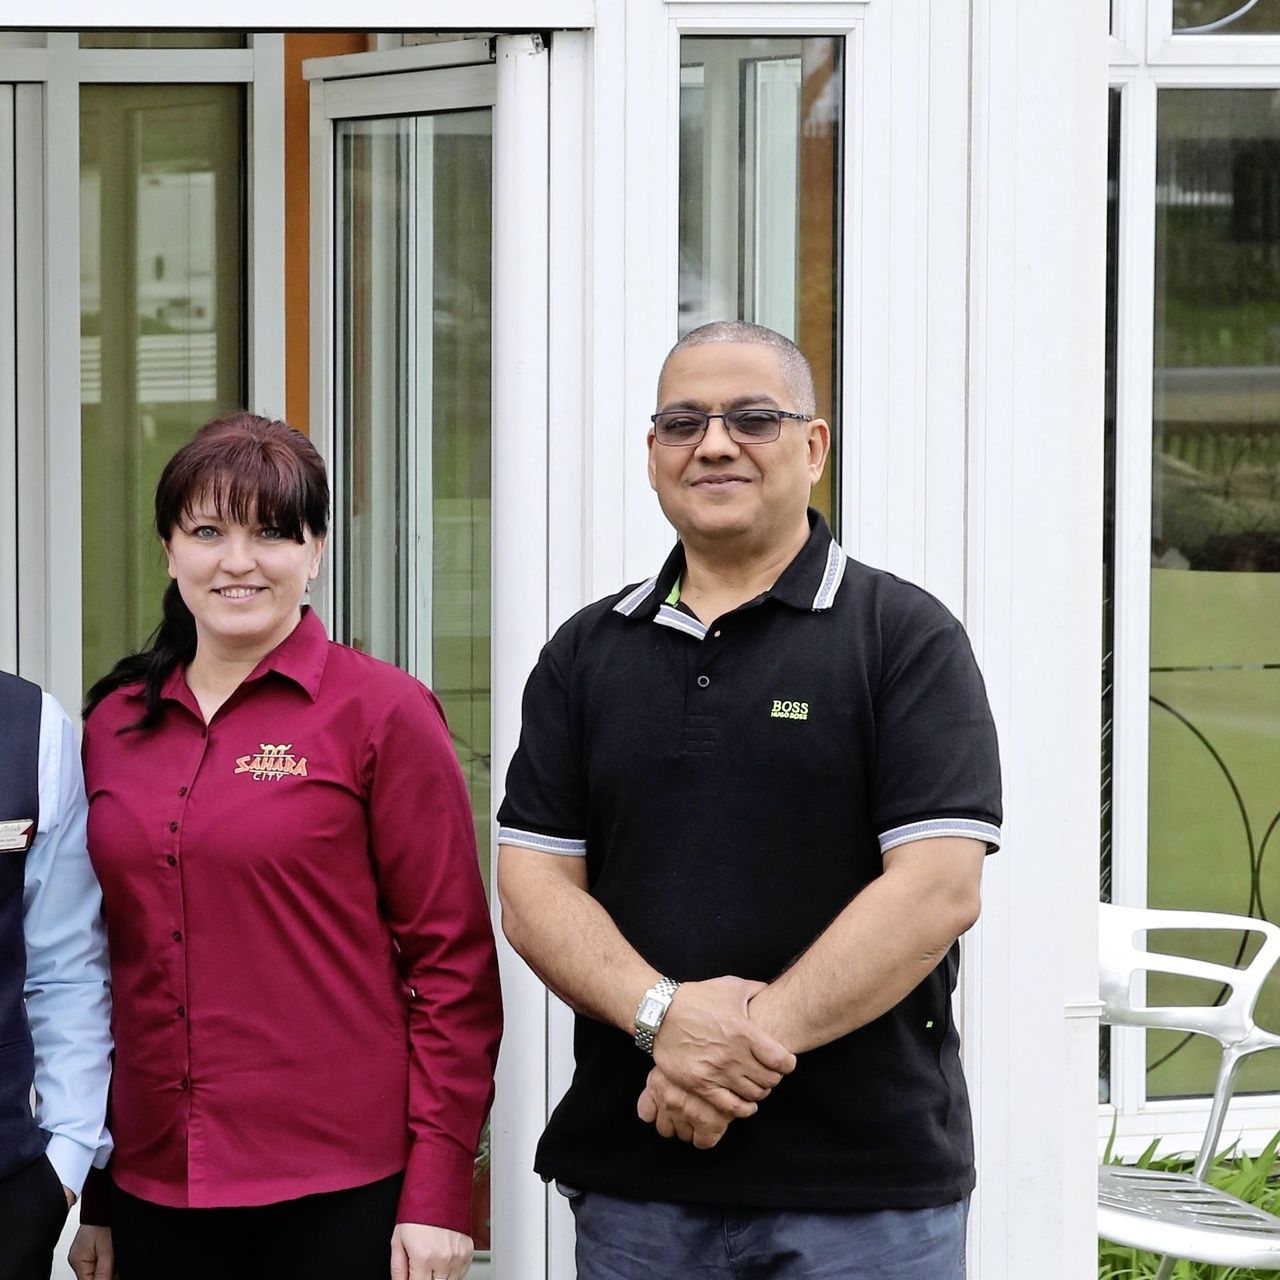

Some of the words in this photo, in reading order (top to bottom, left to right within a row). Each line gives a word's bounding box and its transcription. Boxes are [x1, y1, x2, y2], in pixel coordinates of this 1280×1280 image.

[771, 700, 809, 714] BOSS
[790, 712, 808, 720] BOSS
[234, 755, 308, 777] SAHARA
[253, 772, 284, 782] CITY
